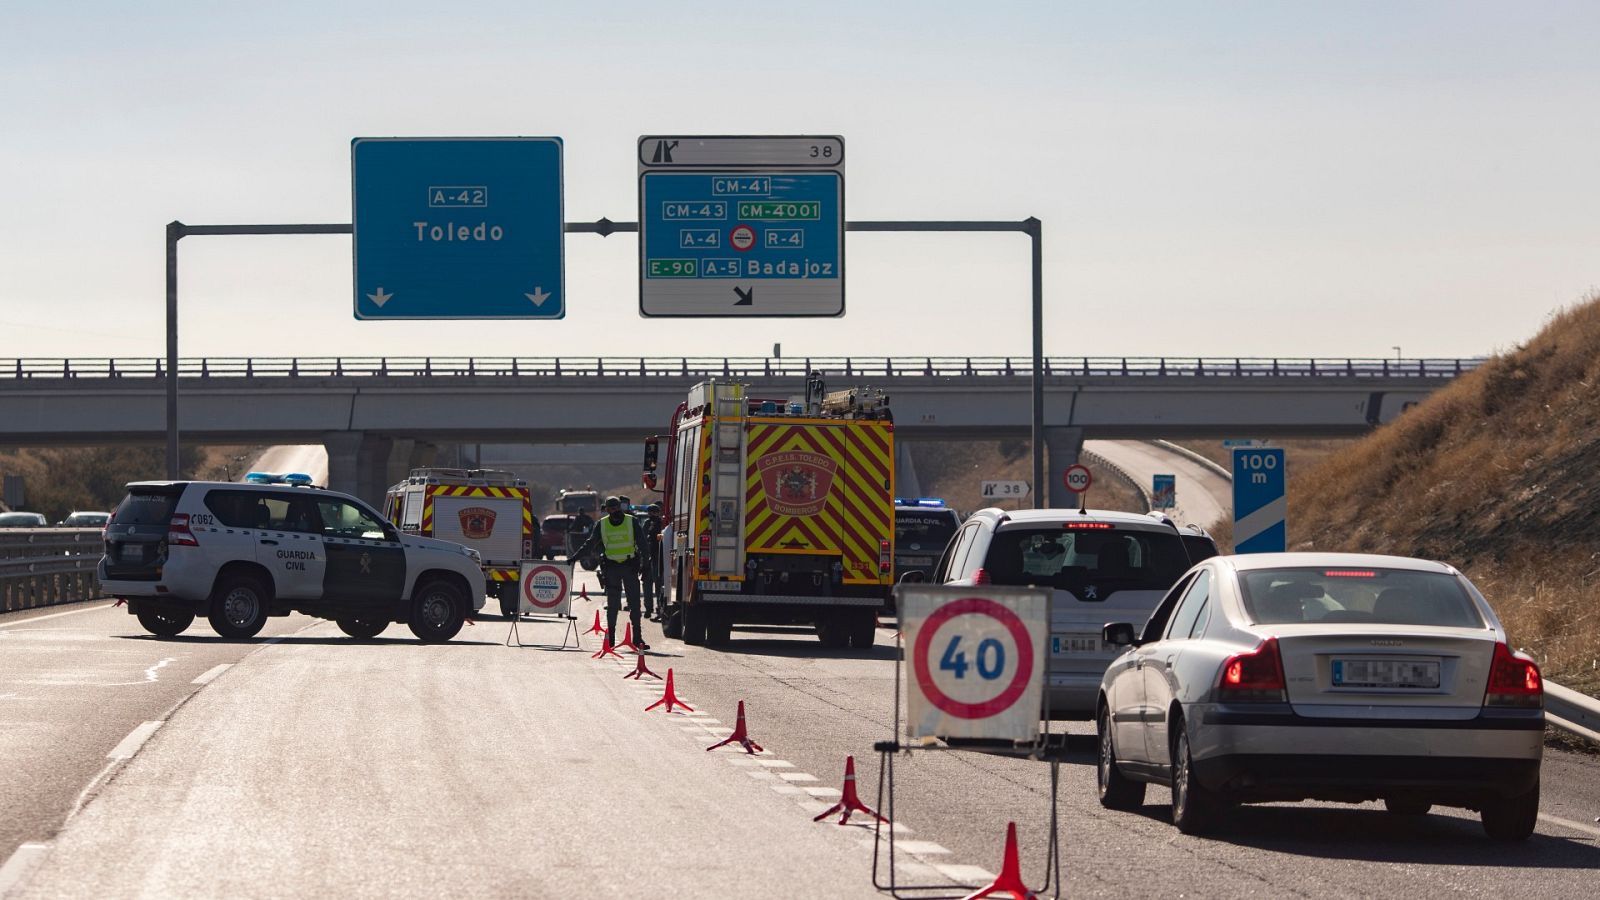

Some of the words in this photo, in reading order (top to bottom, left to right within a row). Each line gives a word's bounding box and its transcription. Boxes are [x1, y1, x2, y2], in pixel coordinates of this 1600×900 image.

[809, 146, 832, 158] 38
[715, 180, 769, 193] CM-41
[433, 190, 484, 204] A-42
[666, 205, 724, 217] CM-43
[741, 204, 819, 217] CM-4001
[413, 222, 504, 241] Toledo
[684, 232, 717, 245] A-4
[768, 232, 800, 245] R-4
[651, 262, 694, 274] E-90
[705, 262, 737, 274] A-5
[748, 259, 832, 278] Badajoz
[799, 454, 829, 467] TOLEDO
[1241, 454, 1277, 470] 100
[1068, 474, 1088, 484] 100
[1251, 472, 1267, 484] m
[1004, 484, 1020, 494] 38
[774, 503, 818, 514] BOMBEROS
[197, 513, 214, 525] 062
[277, 549, 316, 560] GUARDIA
[285, 561, 306, 571] CIVIL
[939, 635, 1006, 681] 40
